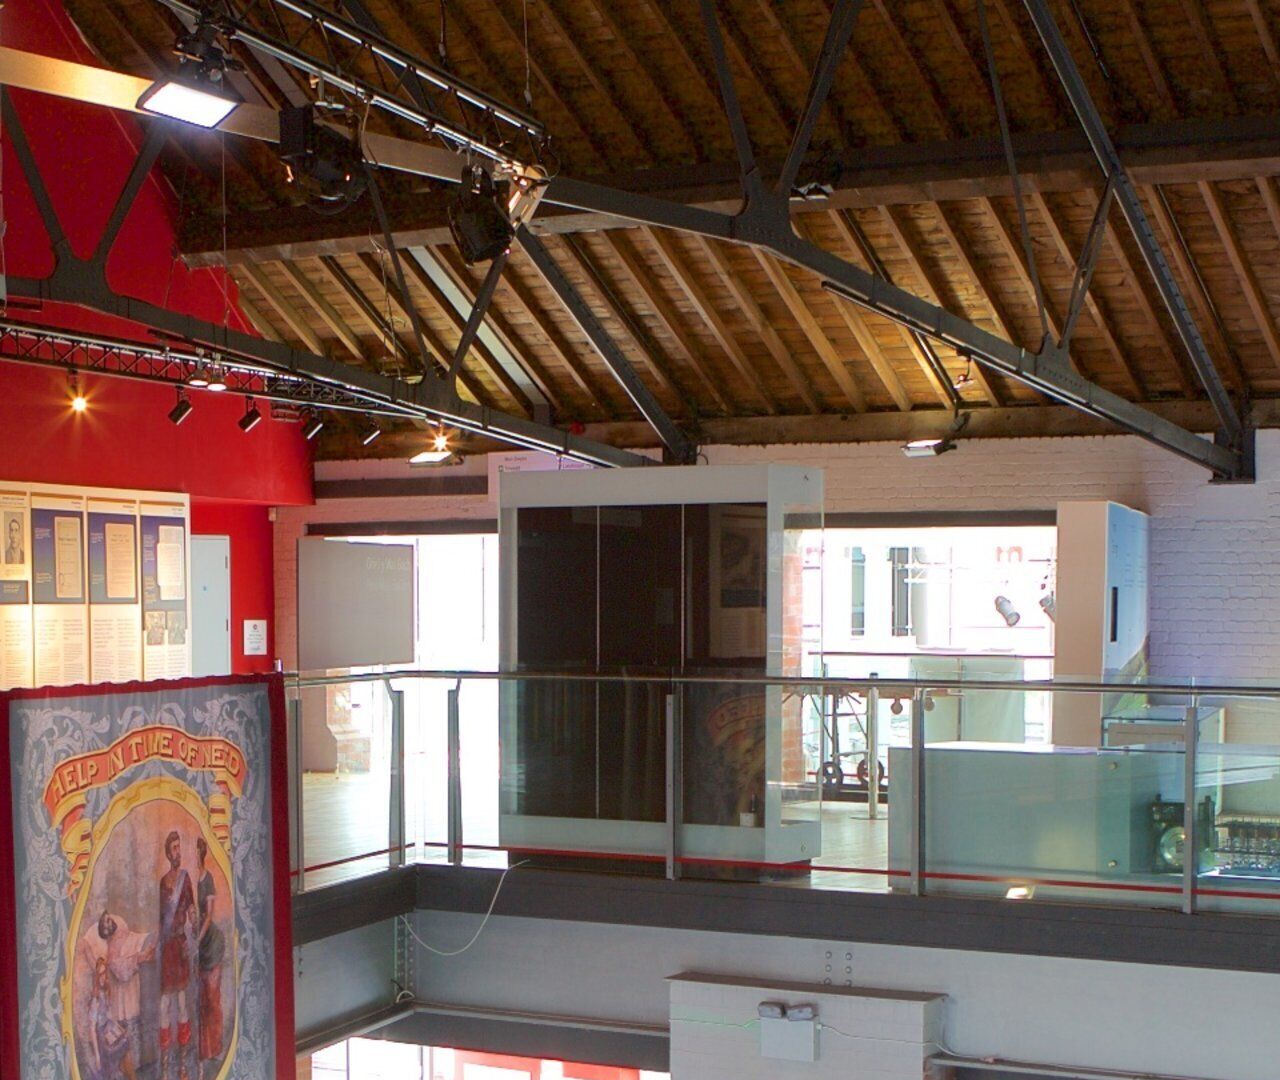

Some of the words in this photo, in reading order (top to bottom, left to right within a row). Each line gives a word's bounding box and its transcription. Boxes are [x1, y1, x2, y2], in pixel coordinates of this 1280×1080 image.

[53, 760, 100, 800] HELP
[108, 747, 126, 780] IN
[128, 732, 174, 762] TIME
[178, 738, 199, 767] OF
[201, 744, 242, 777] NEED
